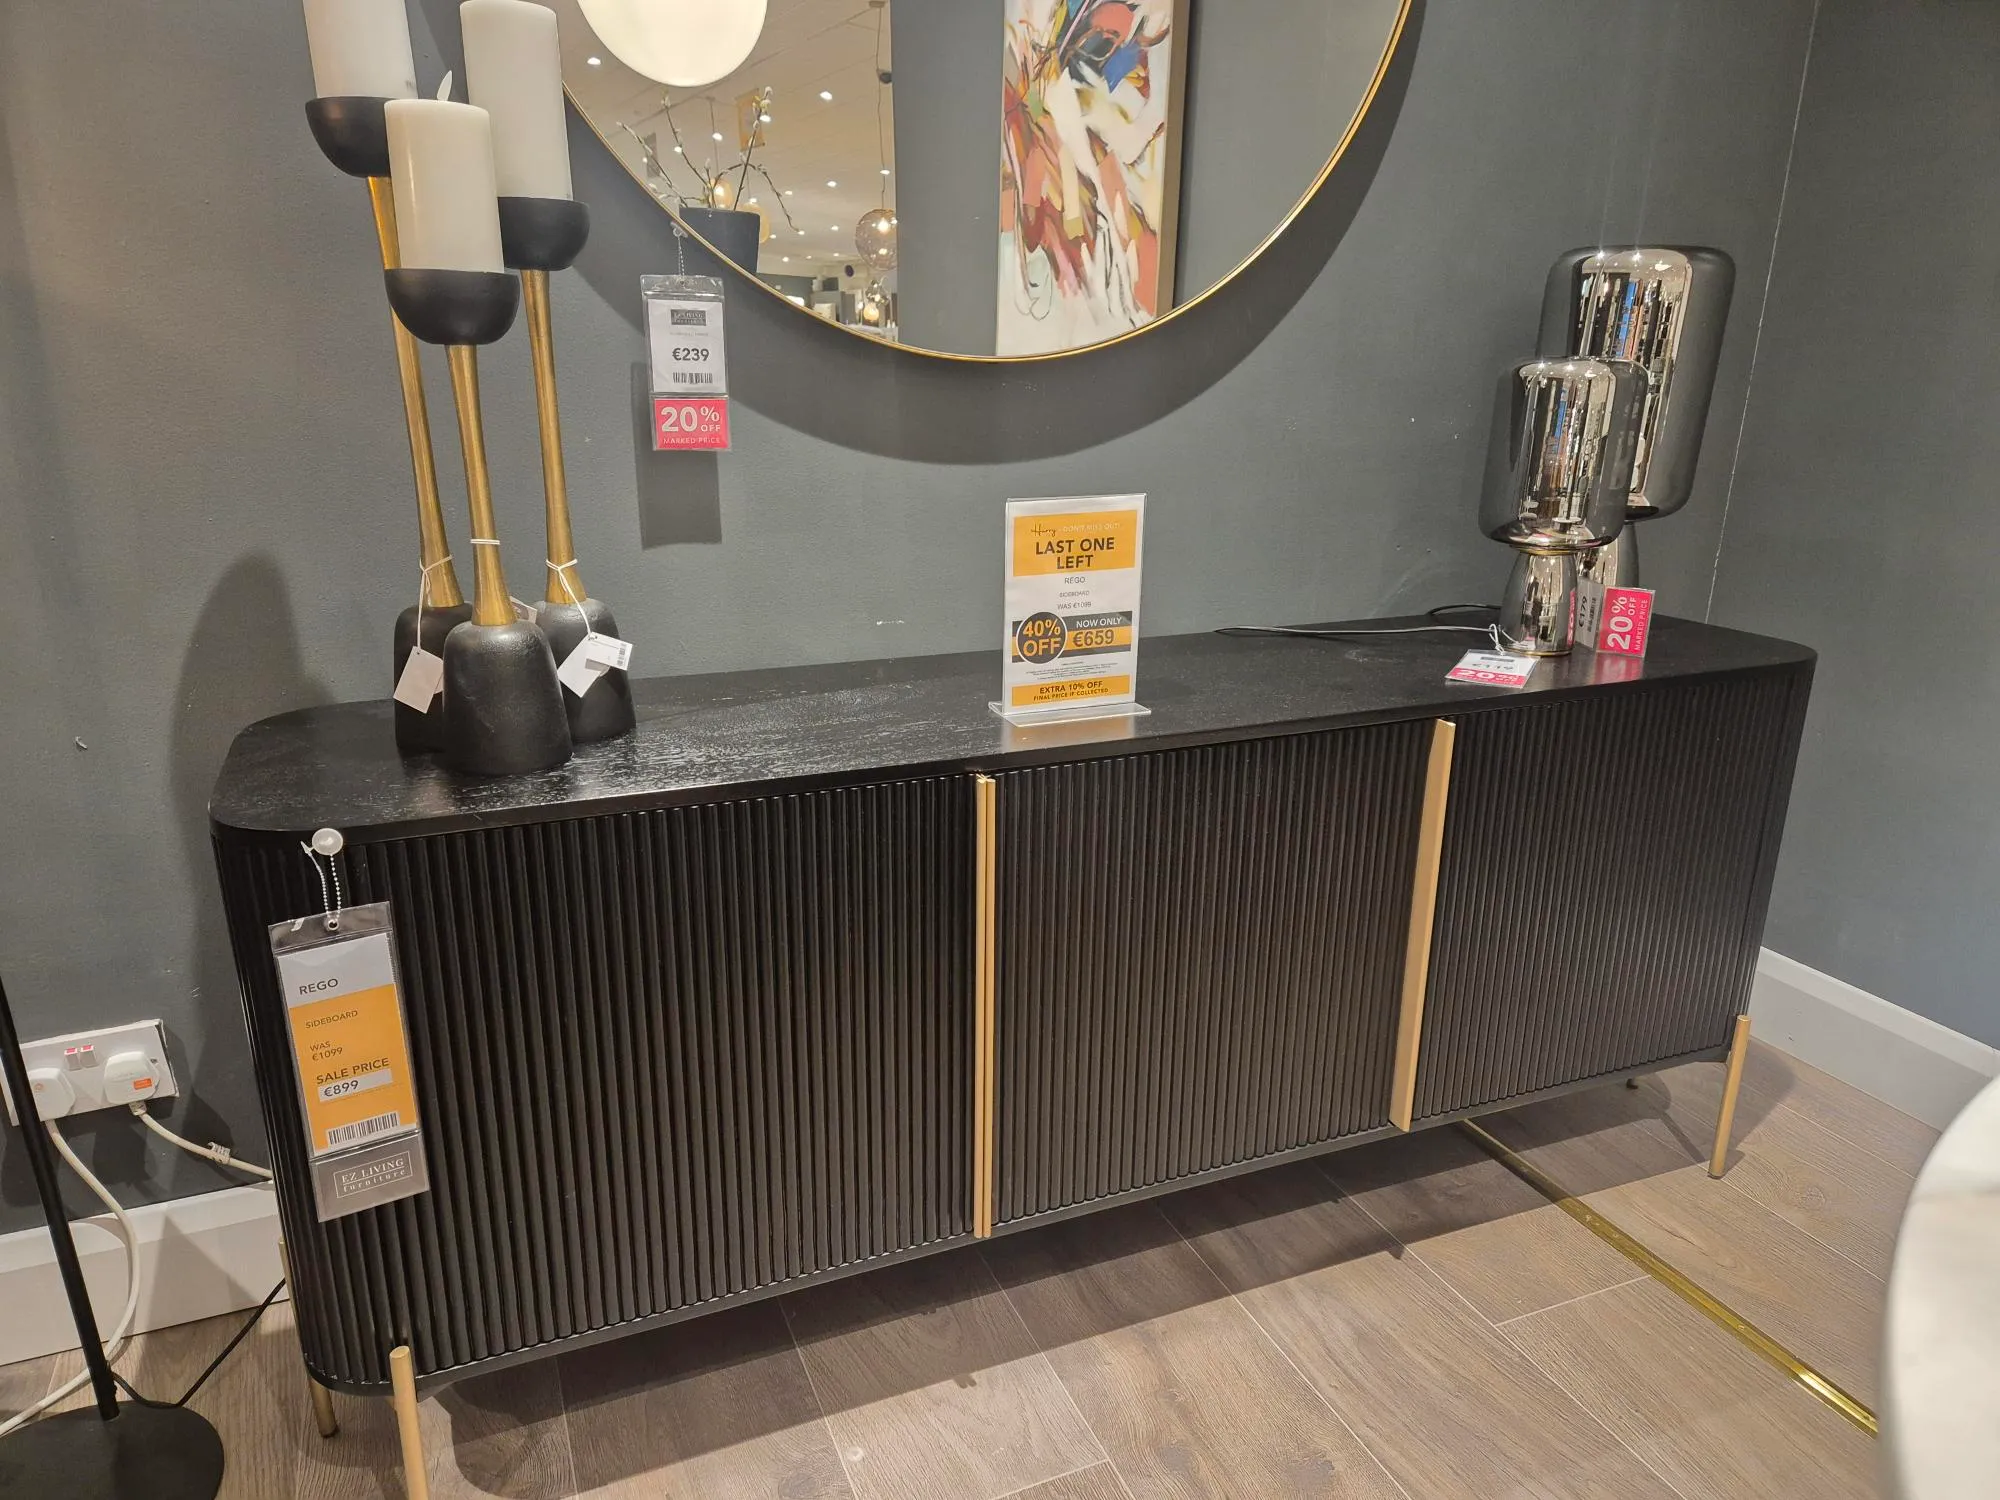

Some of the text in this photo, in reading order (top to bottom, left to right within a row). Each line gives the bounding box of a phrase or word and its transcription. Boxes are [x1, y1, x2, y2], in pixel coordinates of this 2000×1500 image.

[672, 348, 709, 361] €239
[661, 406, 720, 432] 20%
[1035, 537, 1115, 555] LAST ONE
[1057, 555, 1094, 569] LEFT
[1065, 576, 1086, 584] REGO
[1057, 602, 1072, 610] WAS
[1627, 597, 1637, 616] OFF
[1022, 619, 1061, 637] 40%
[1076, 617, 1122, 628] NOW ONLY
[1606, 596, 1633, 650] 20%
[1634, 599, 1648, 650] MARKED PRICE
[1072, 629, 1115, 647] €659
[1023, 638, 1061, 657] OFF
[1039, 681, 1103, 694] EXTRA 10% OFF
[1076, 688, 1109, 696] COLLECTED
[298, 978, 338, 995] REGO
[305, 1010, 358, 1029] SIDEBOARD
[310, 1041, 331, 1051] WAS
[312, 1047, 343, 1062] €1099
[316, 1058, 390, 1085] SALE PRICE
[324, 1079, 359, 1097] €899
[341, 1158, 405, 1184] EZ LIVING
